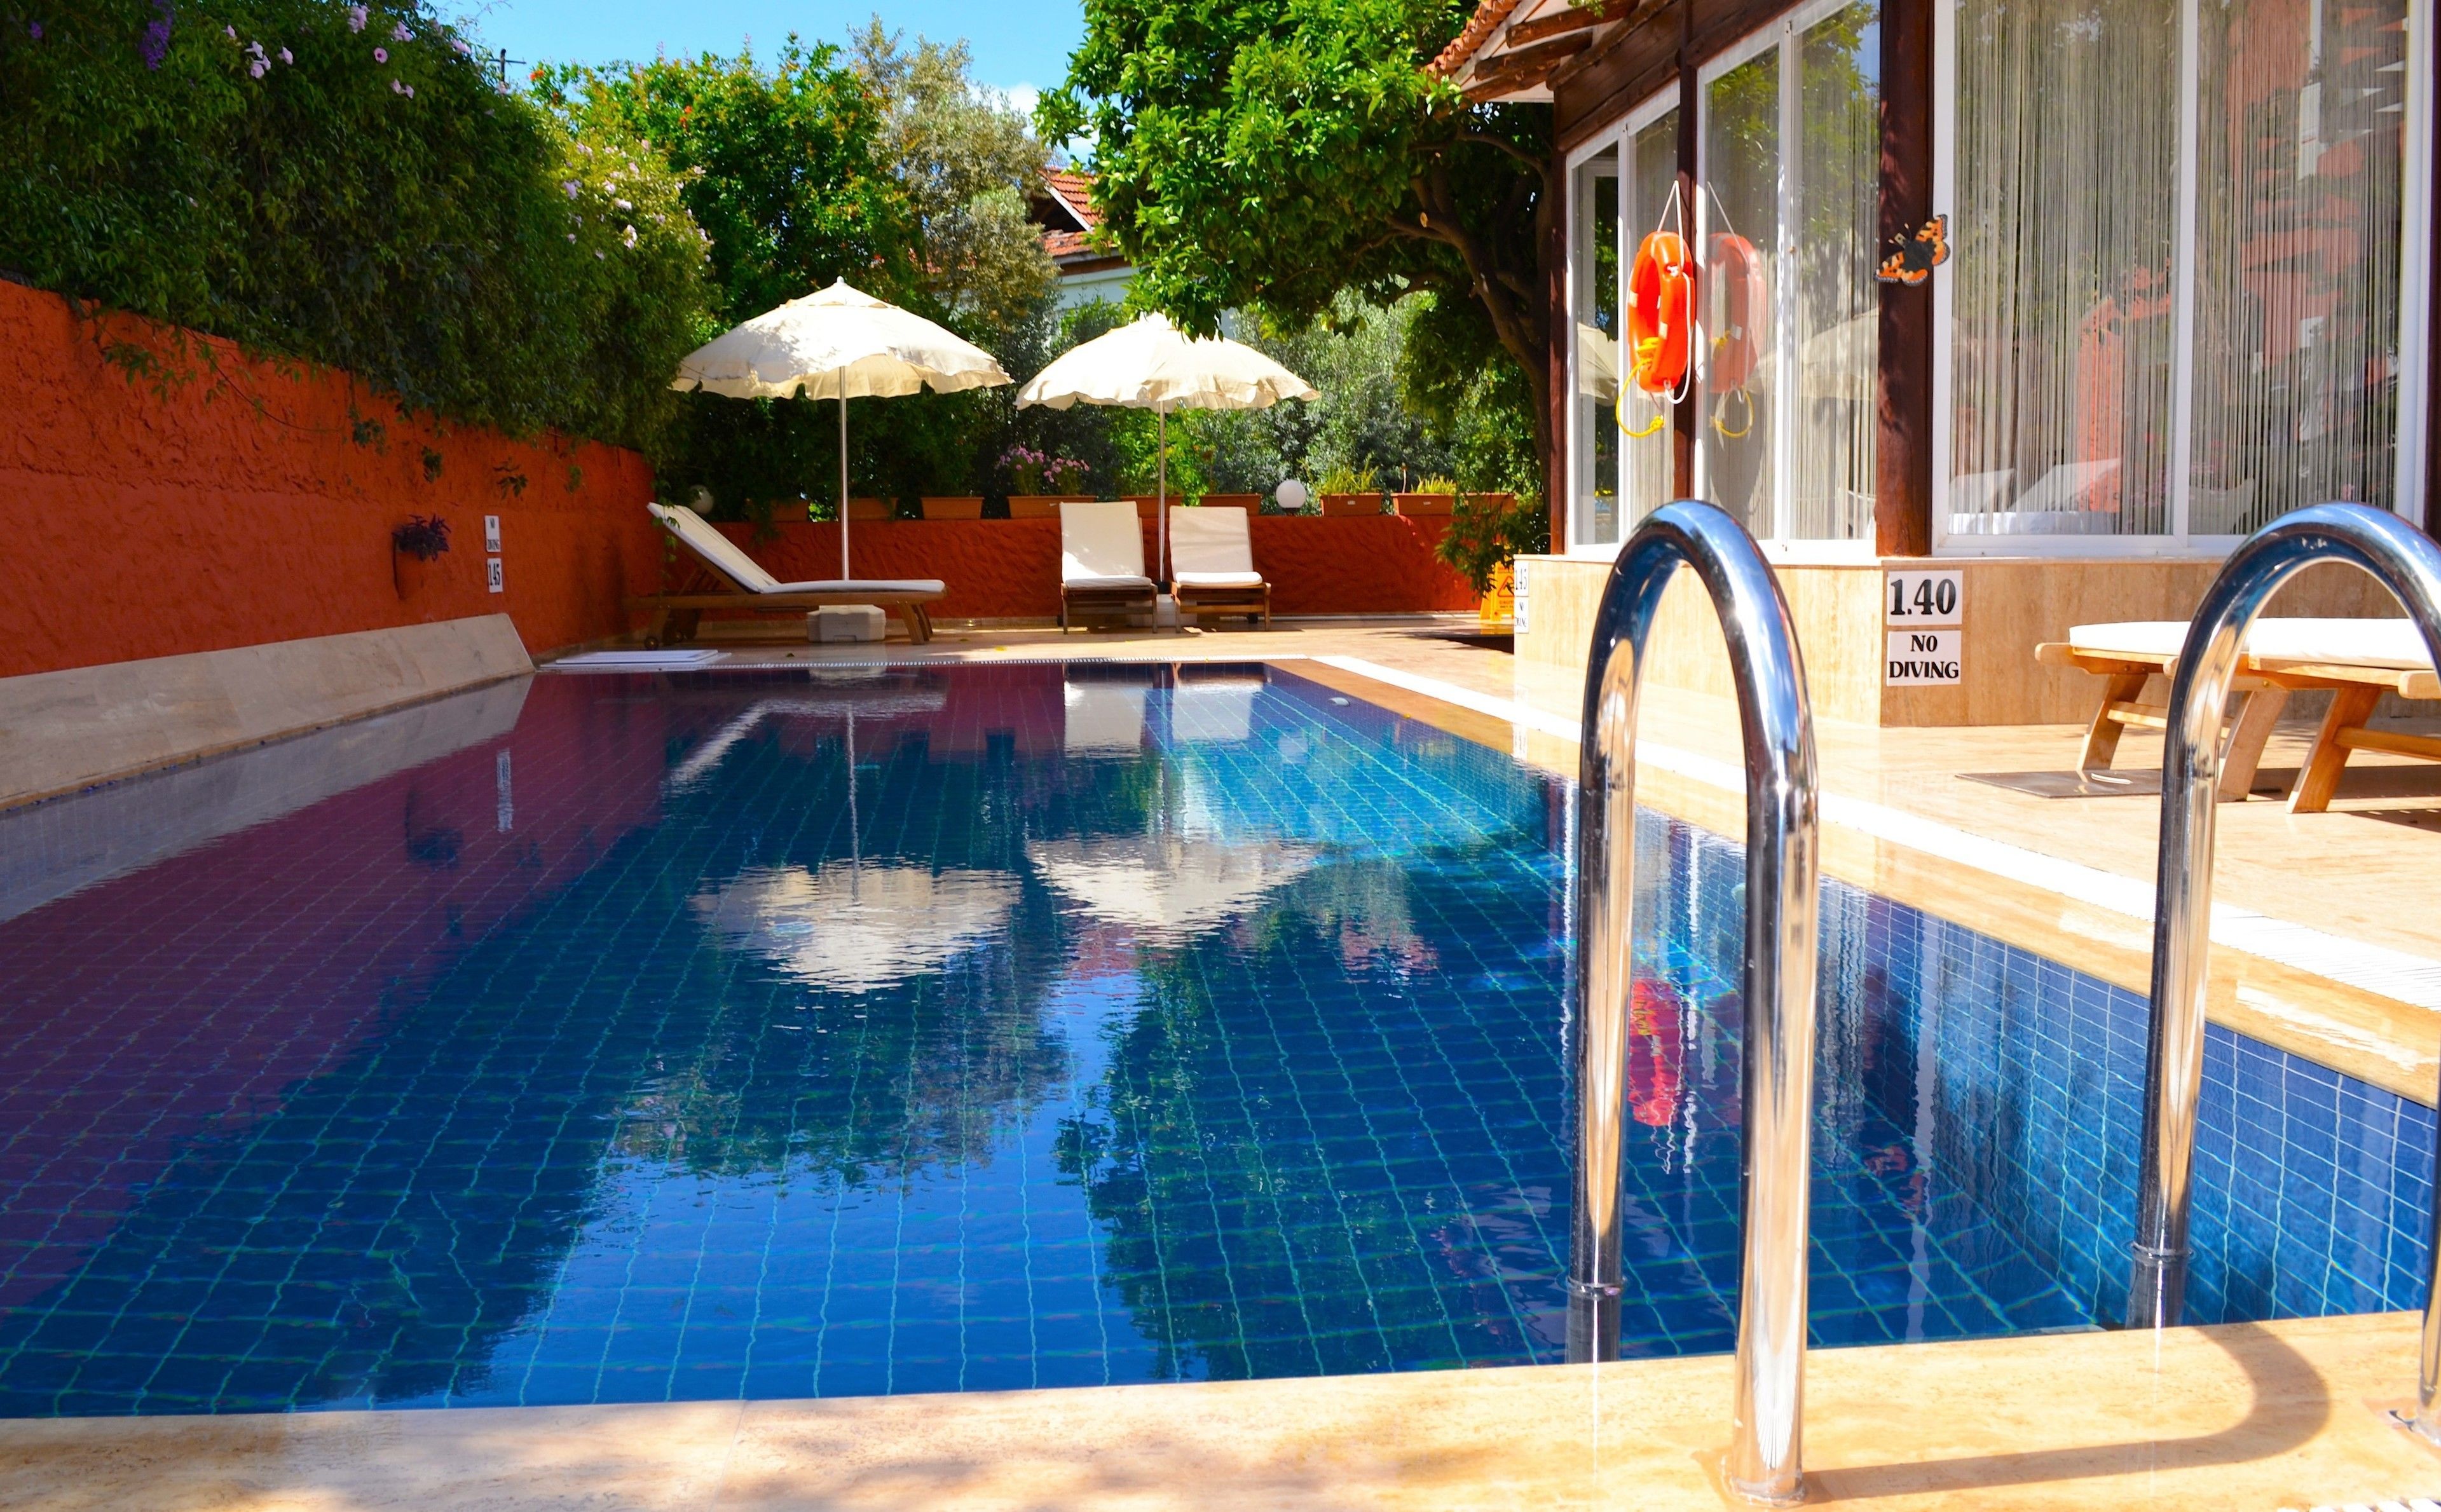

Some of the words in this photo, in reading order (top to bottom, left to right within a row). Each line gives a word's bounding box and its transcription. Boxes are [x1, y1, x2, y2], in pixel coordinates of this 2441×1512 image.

[1891, 578, 1956, 615] 1.40
[1910, 635, 1938, 652] NO
[1889, 661, 1959, 679] DIVING
